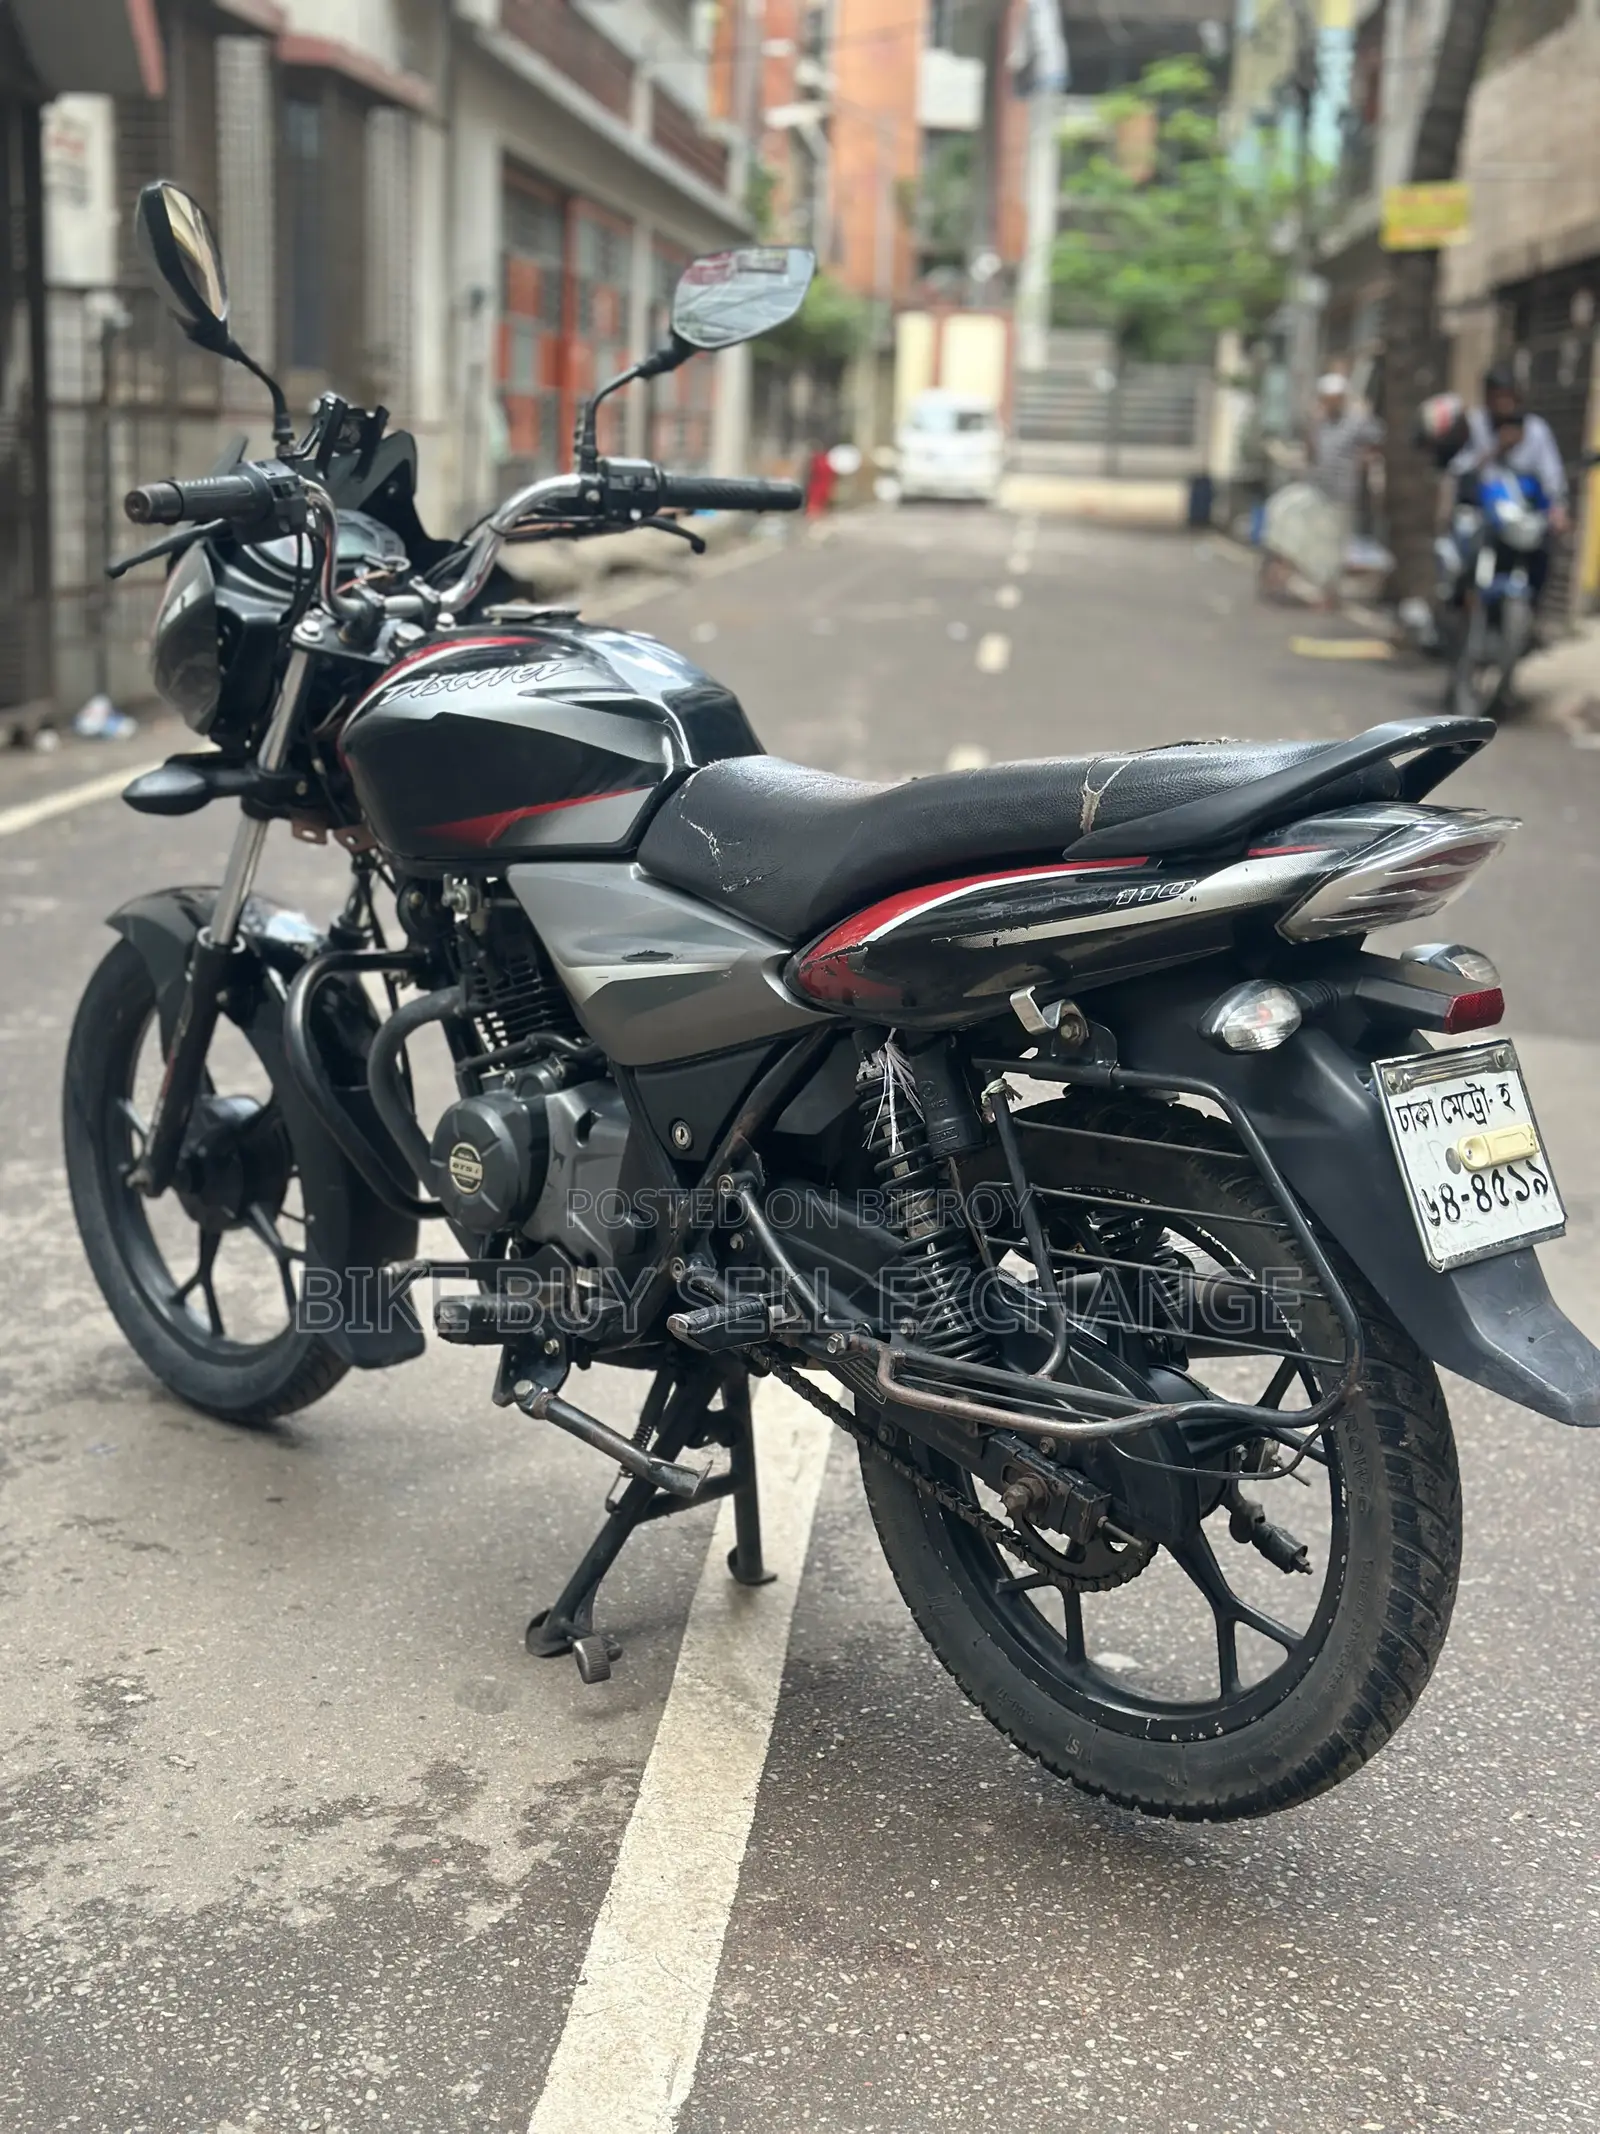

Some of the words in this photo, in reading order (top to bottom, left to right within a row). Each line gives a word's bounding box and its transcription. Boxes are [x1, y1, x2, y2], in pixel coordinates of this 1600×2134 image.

[379, 662, 583, 706] Discover
[1116, 879, 1197, 905] 110
[1395, 1098, 1439, 1133] ঢাকা
[1498, 1083, 1516, 1112] হ
